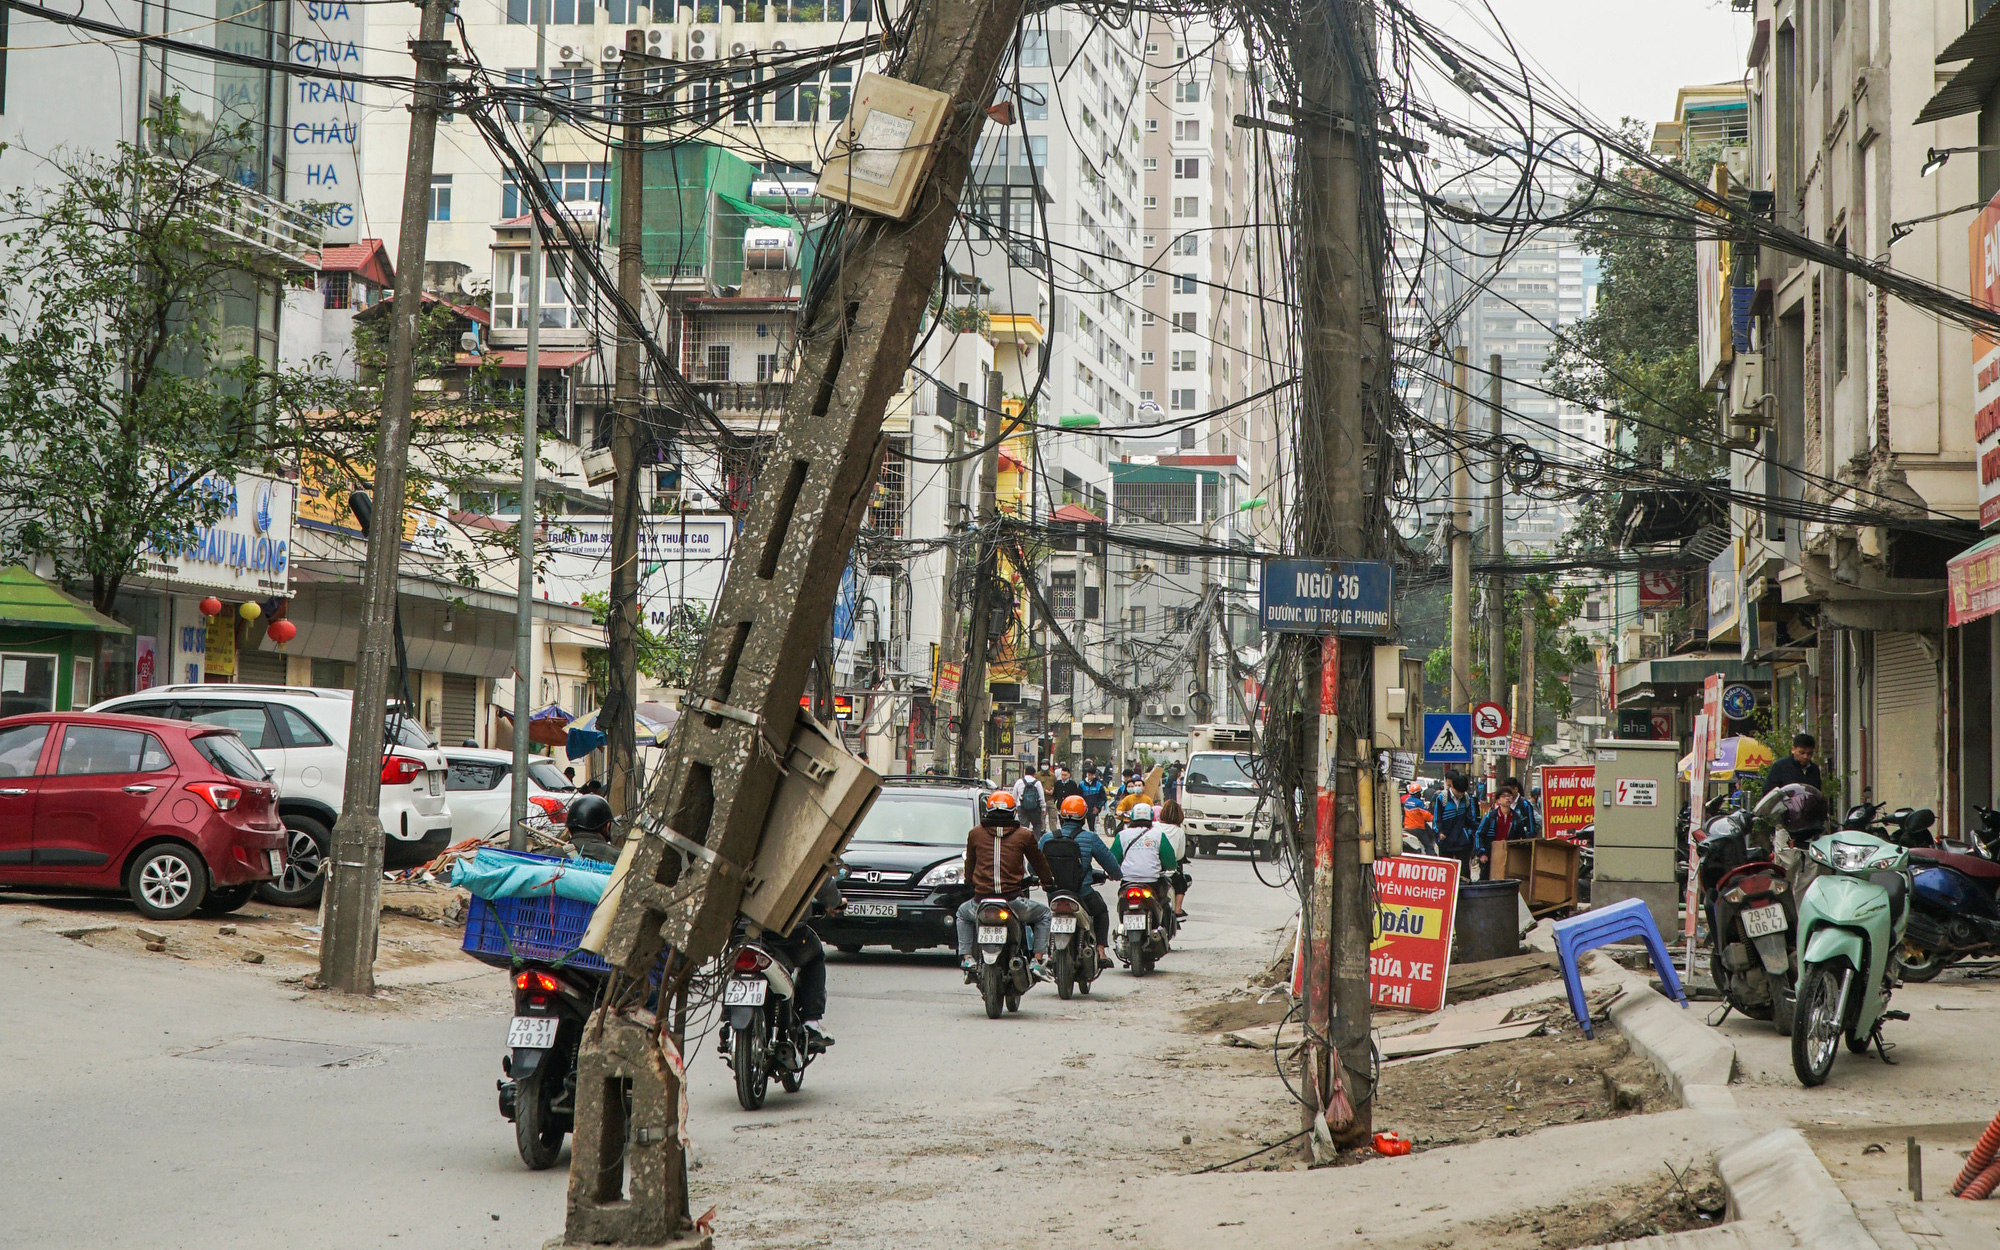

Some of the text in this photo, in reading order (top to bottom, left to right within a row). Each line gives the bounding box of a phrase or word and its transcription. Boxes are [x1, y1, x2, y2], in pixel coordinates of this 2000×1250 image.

[293, 117, 357, 144] CHÂU
[307, 164, 338, 190] HẠ
[691, 534, 709, 543] CAO
[229, 532, 247, 576] HẠ
[251, 536, 287, 573] LONG
[1296, 567, 1360, 600] NGÕ 36
[1304, 605, 1317, 622] VŨ
[1354, 610, 1388, 628] PHỤNG
[1622, 719, 1648, 733] aha
[1550, 795, 1576, 811] THỊT
[1397, 863, 1447, 883] MOTOR
[1404, 885, 1446, 902] NGHIỆP
[1748, 907, 1778, 922] 29-D2
[1408, 961, 1434, 981] XE
[1379, 984, 1412, 1005] PHÍ
[516, 1019, 551, 1032] 29-S1
[509, 1032, 551, 1047] 219.21
